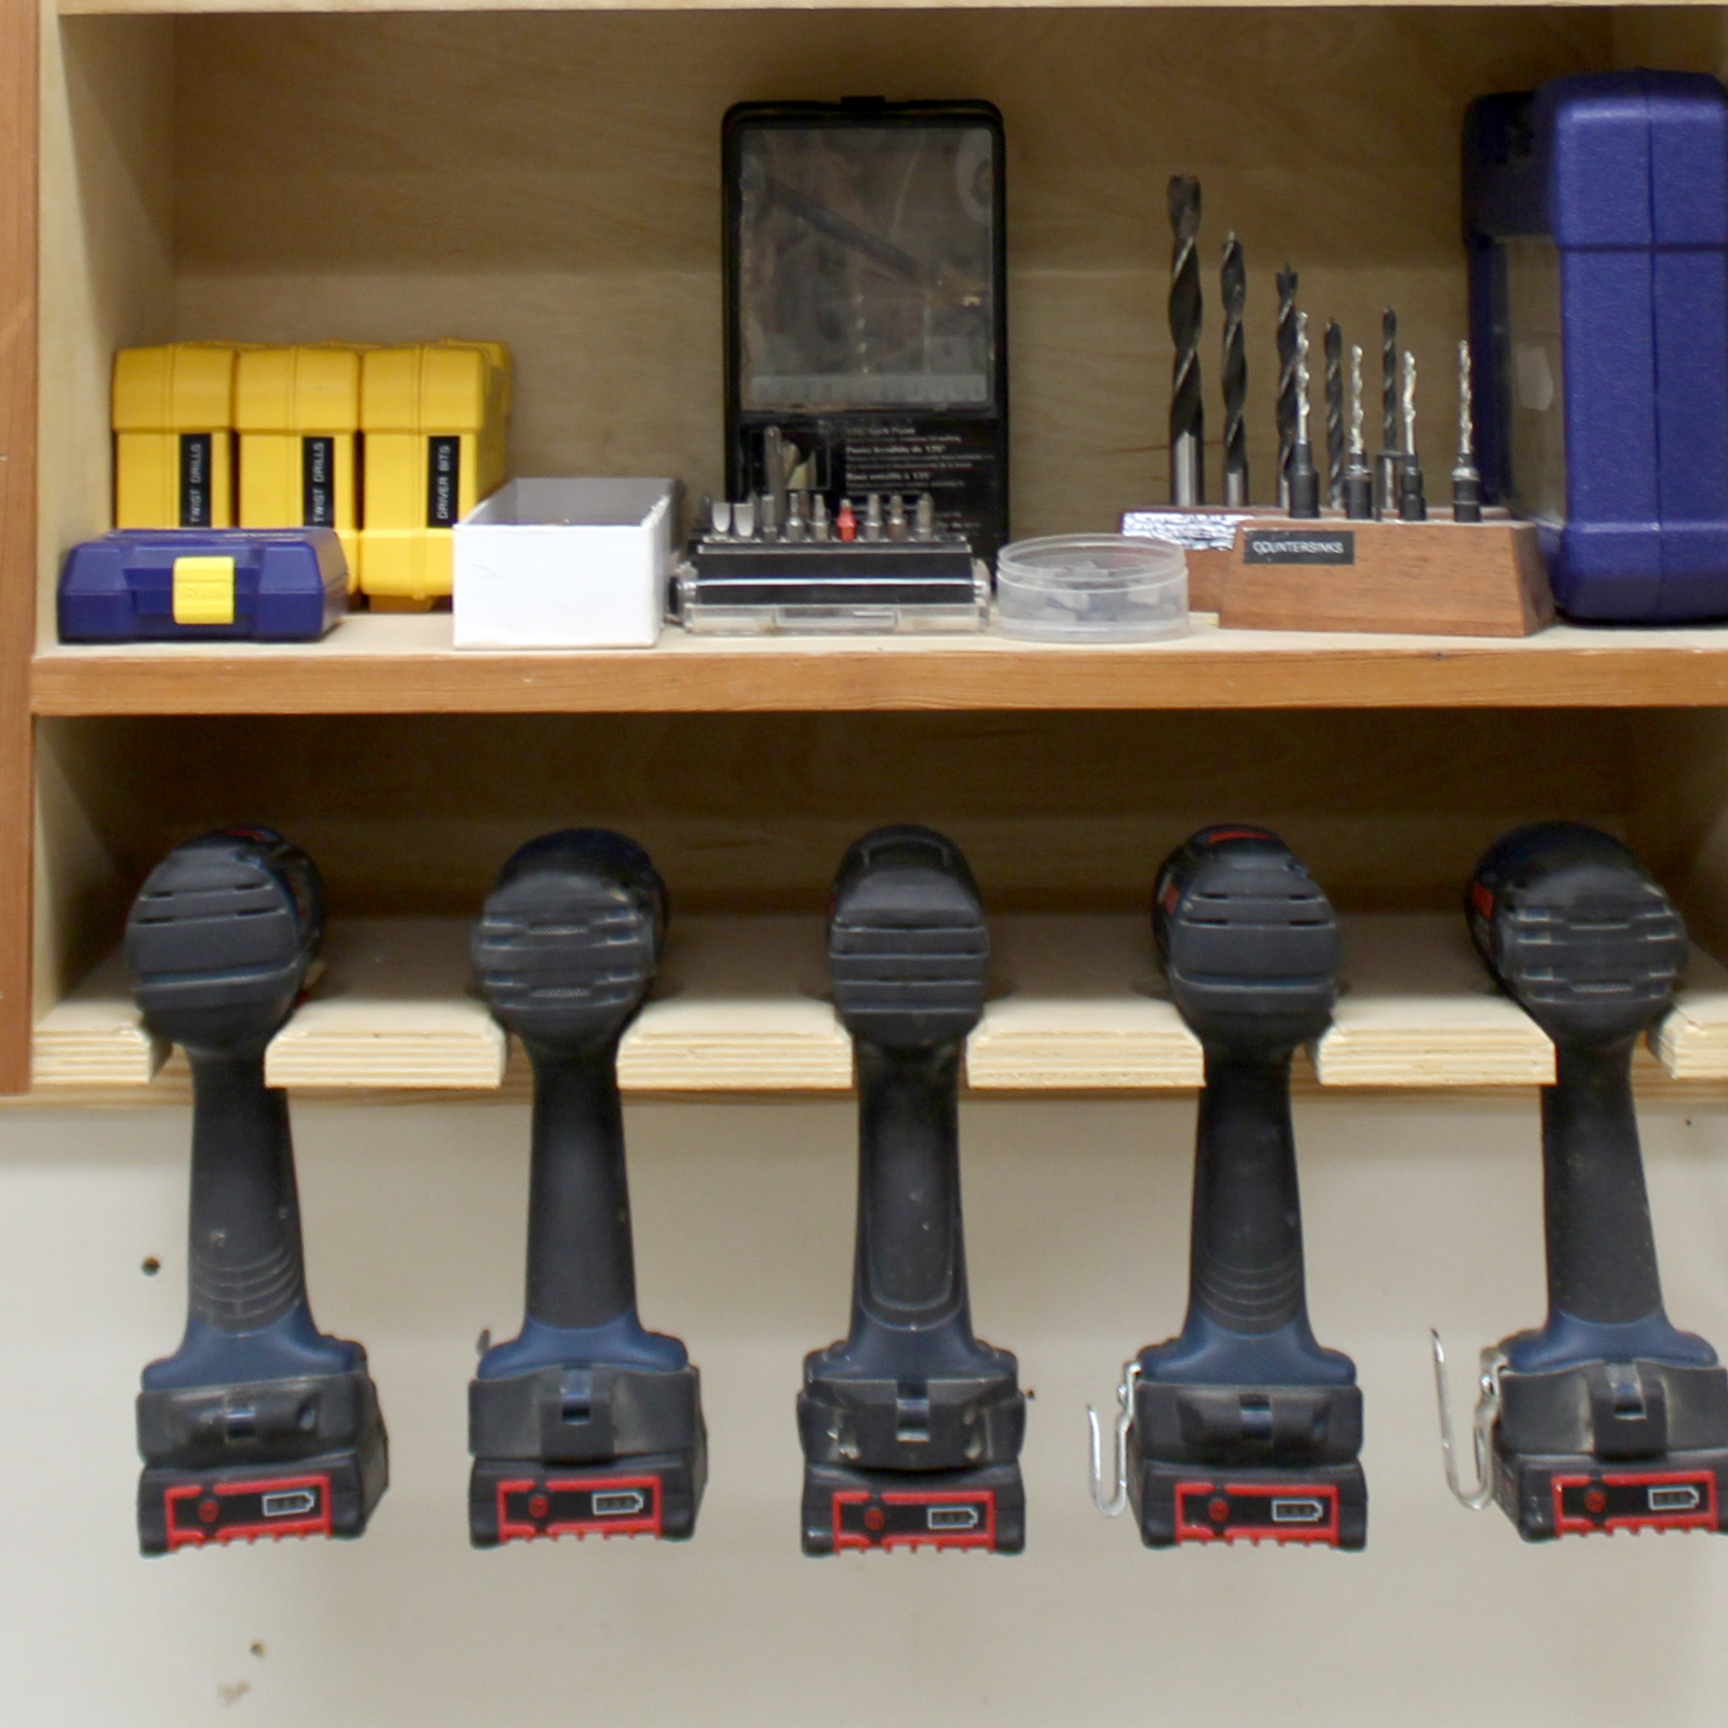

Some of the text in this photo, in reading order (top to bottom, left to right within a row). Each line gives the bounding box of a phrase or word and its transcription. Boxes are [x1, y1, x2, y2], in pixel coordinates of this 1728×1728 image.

[437, 444, 452, 519] DRIVER BITS
[1252, 540, 1344, 555] COUNTERSINKS
